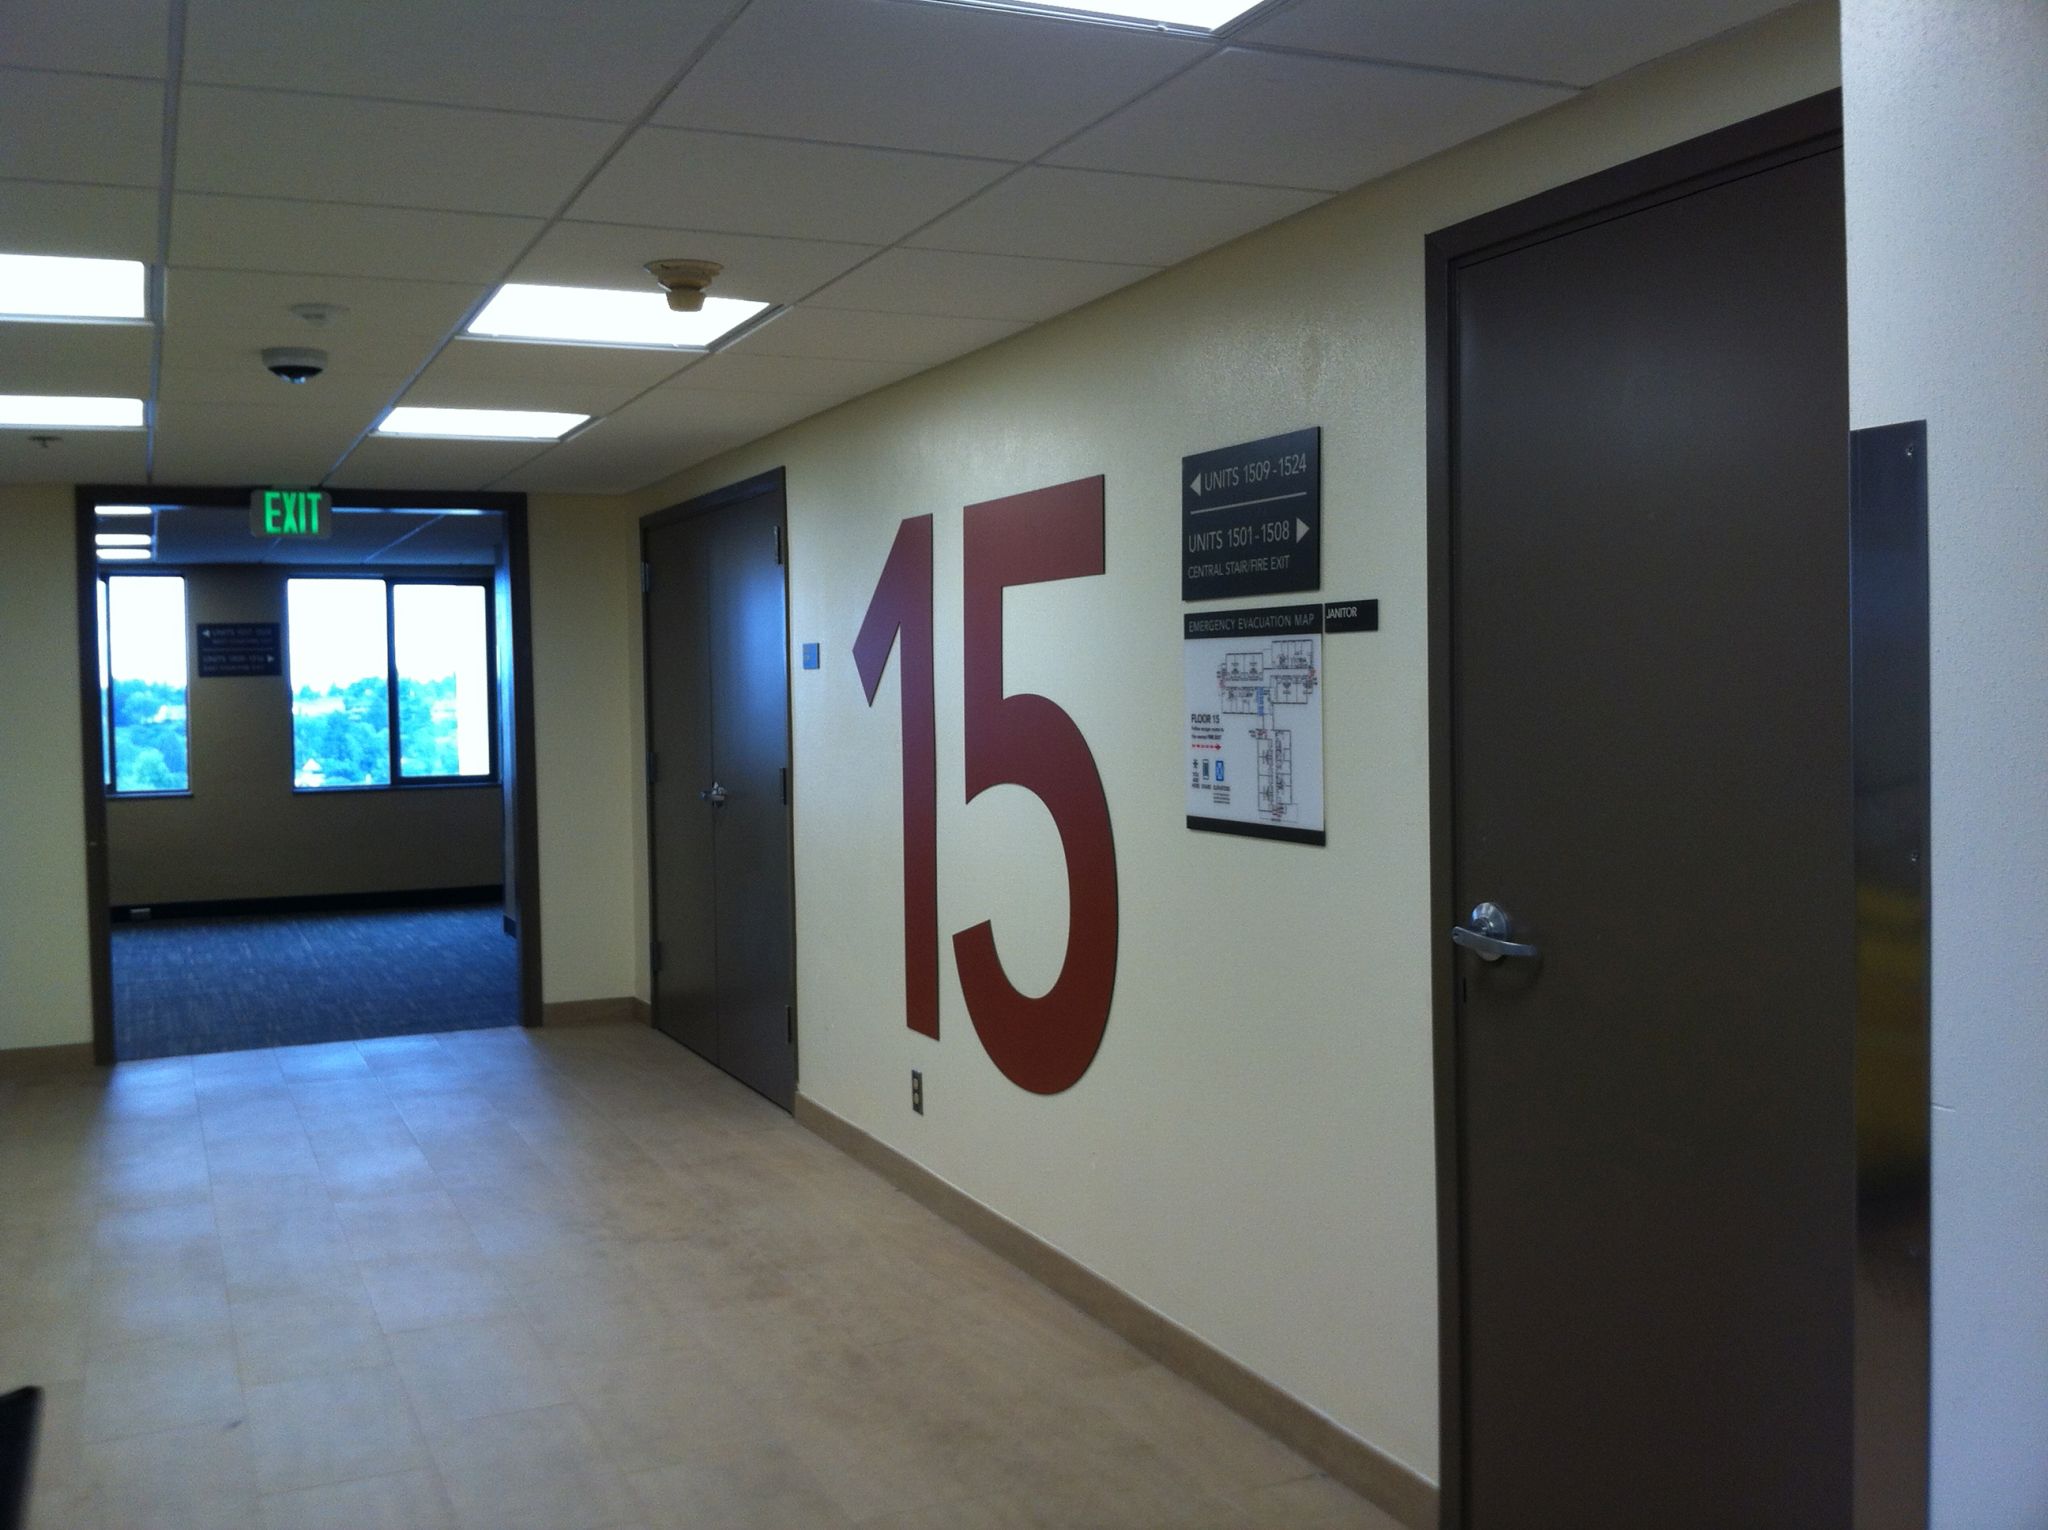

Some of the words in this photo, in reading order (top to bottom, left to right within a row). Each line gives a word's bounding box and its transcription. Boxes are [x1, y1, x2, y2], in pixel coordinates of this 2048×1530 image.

[1205, 467, 1239, 491] UNITS
[264, 491, 322, 534] EXIT
[1189, 530, 1223, 553] UNITS
[1188, 564, 1224, 579] CENTRAL
[1271, 554, 1291, 570] EXIT
[1188, 619, 1236, 633] EMERGENCY
[1238, 615, 1292, 631] EVACUATION
[1294, 612, 1315, 627] MAP
[1326, 606, 1358, 620] JANITOR
[1191, 713, 1211, 724] FLOOR
[1212, 714, 1220, 724] 15
[852, 473, 1119, 1095] 15
